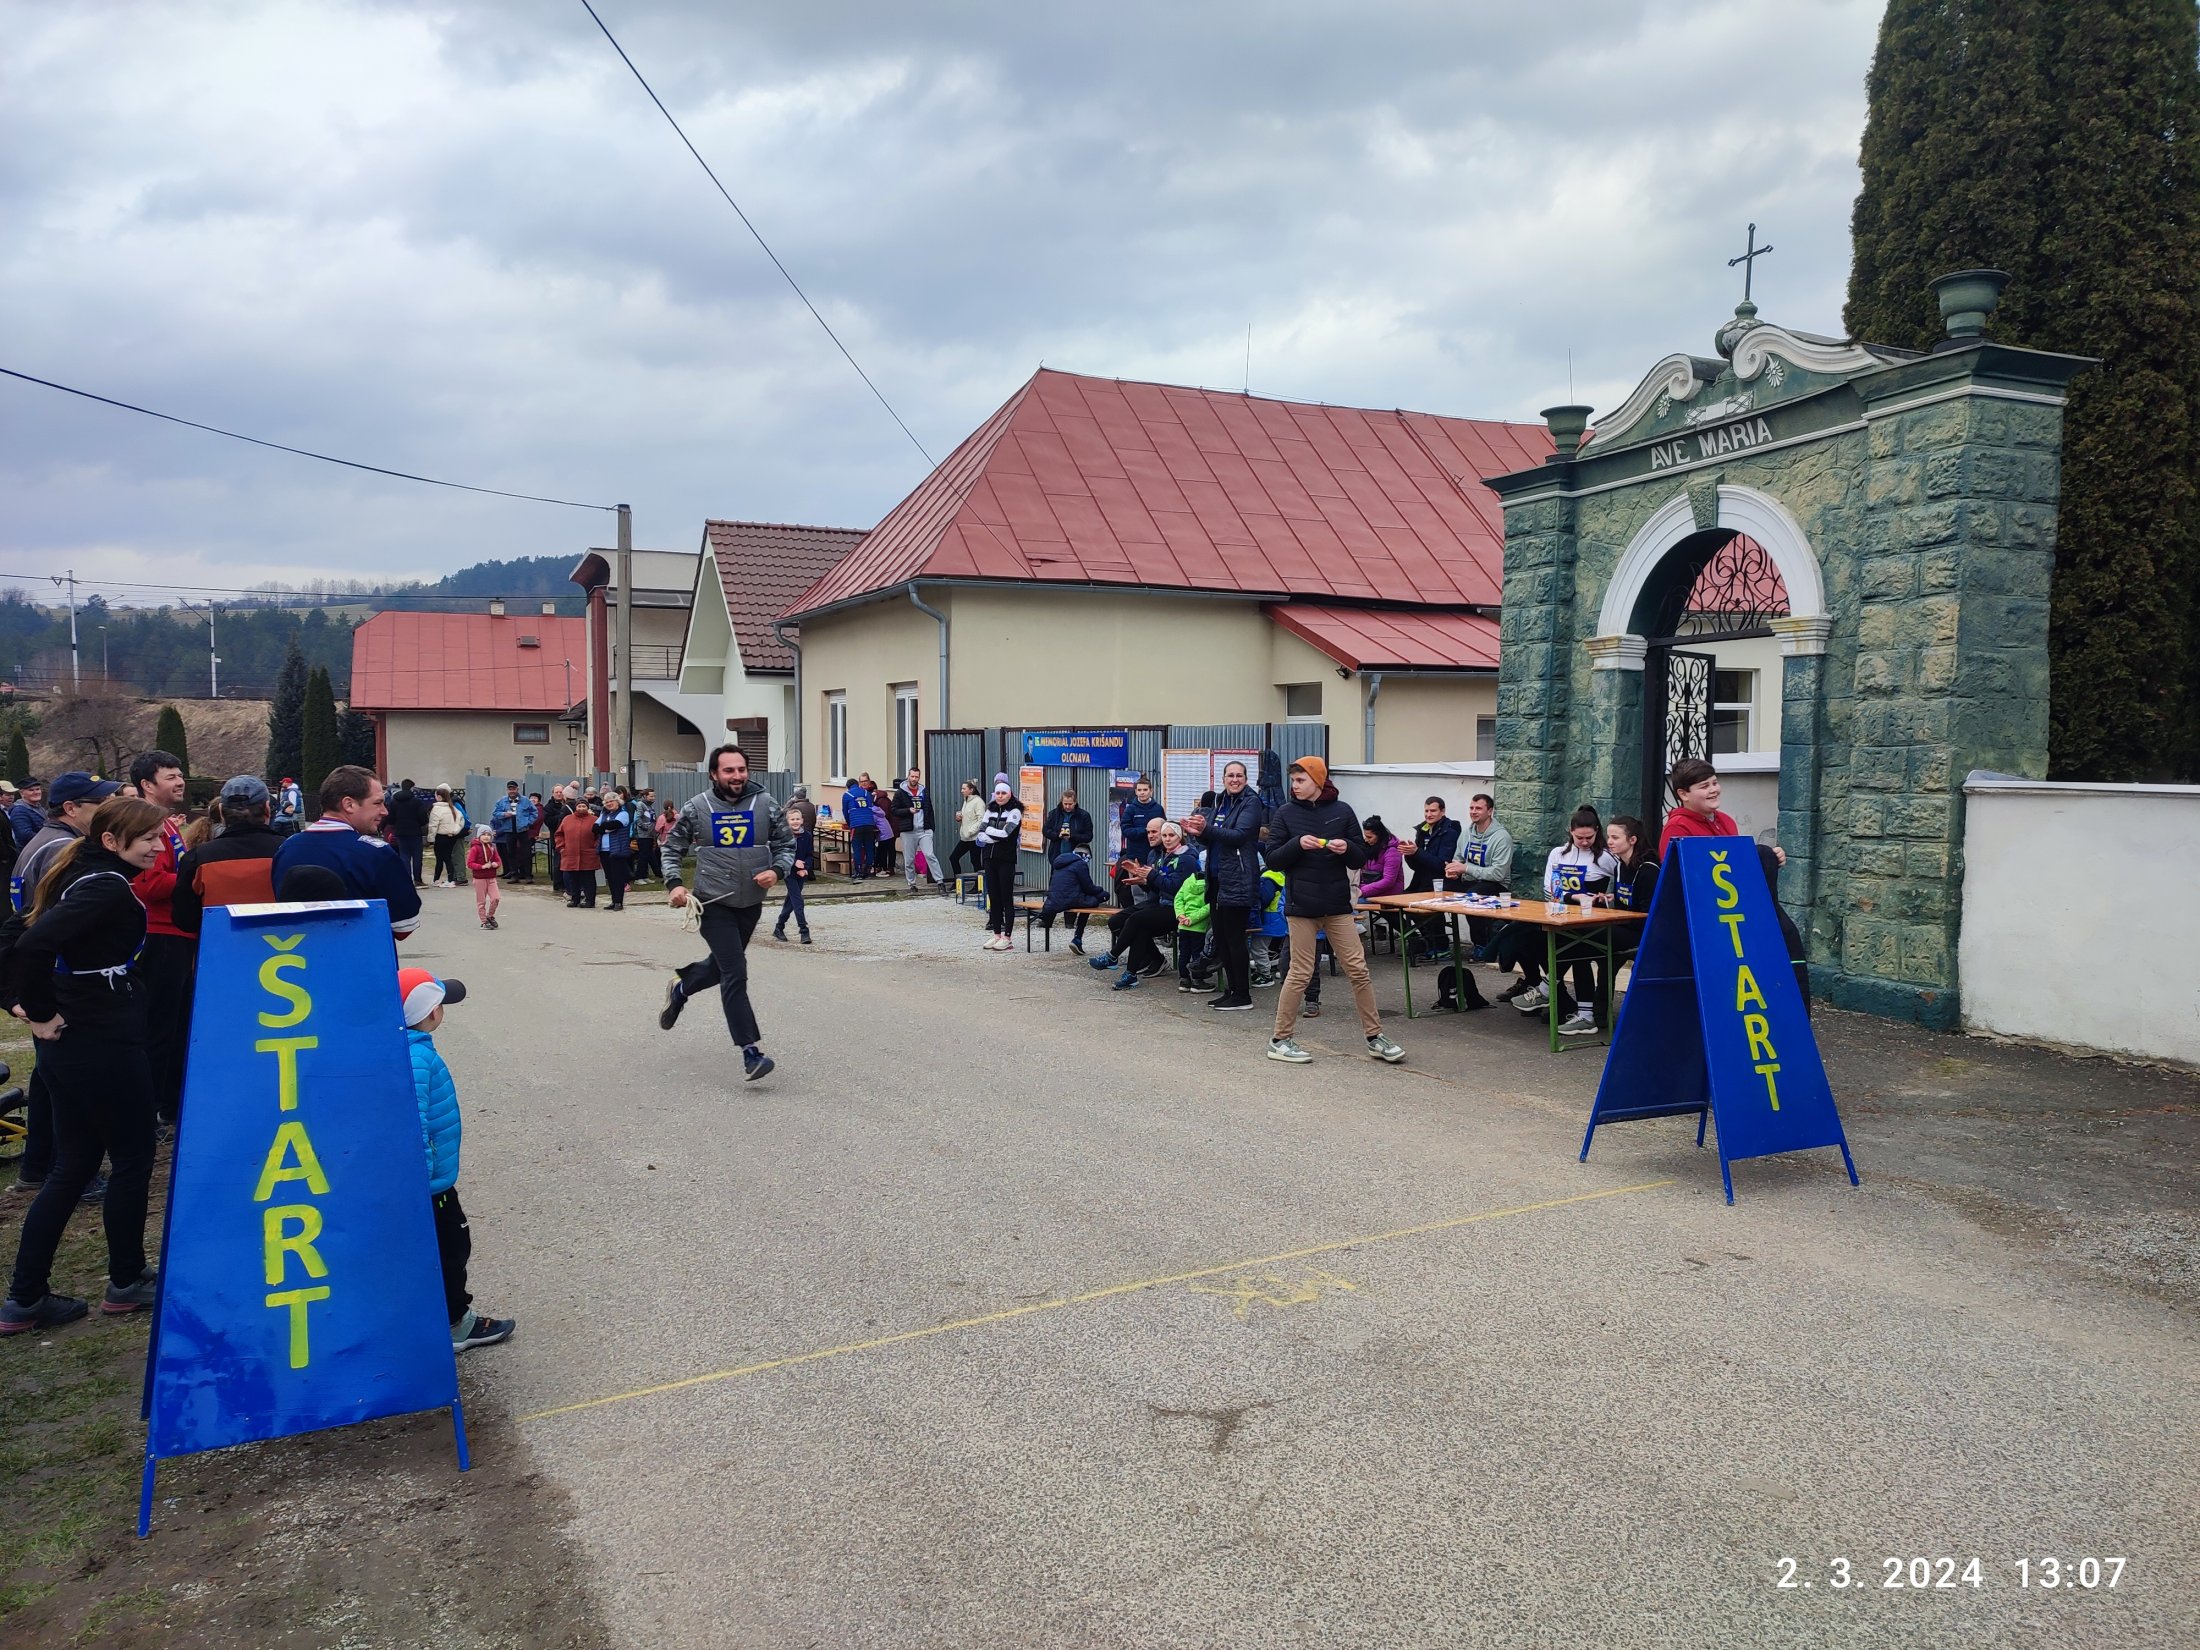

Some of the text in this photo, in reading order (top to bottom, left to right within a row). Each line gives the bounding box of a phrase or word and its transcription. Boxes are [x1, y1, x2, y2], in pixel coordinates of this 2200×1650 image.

[1651, 417, 1773, 470] AVE MARIA
[1069, 736, 1090, 748] JOZEFA
[1091, 733, 1124, 748] KRIŠANDU
[1061, 752, 1091, 764] OLCNAVA
[912, 801, 922, 809] 13
[720, 826, 748, 845] 37
[1560, 876, 1581, 891] 30
[1709, 850, 1781, 1112] ŠTART
[253, 933, 330, 1369] ŠTART
